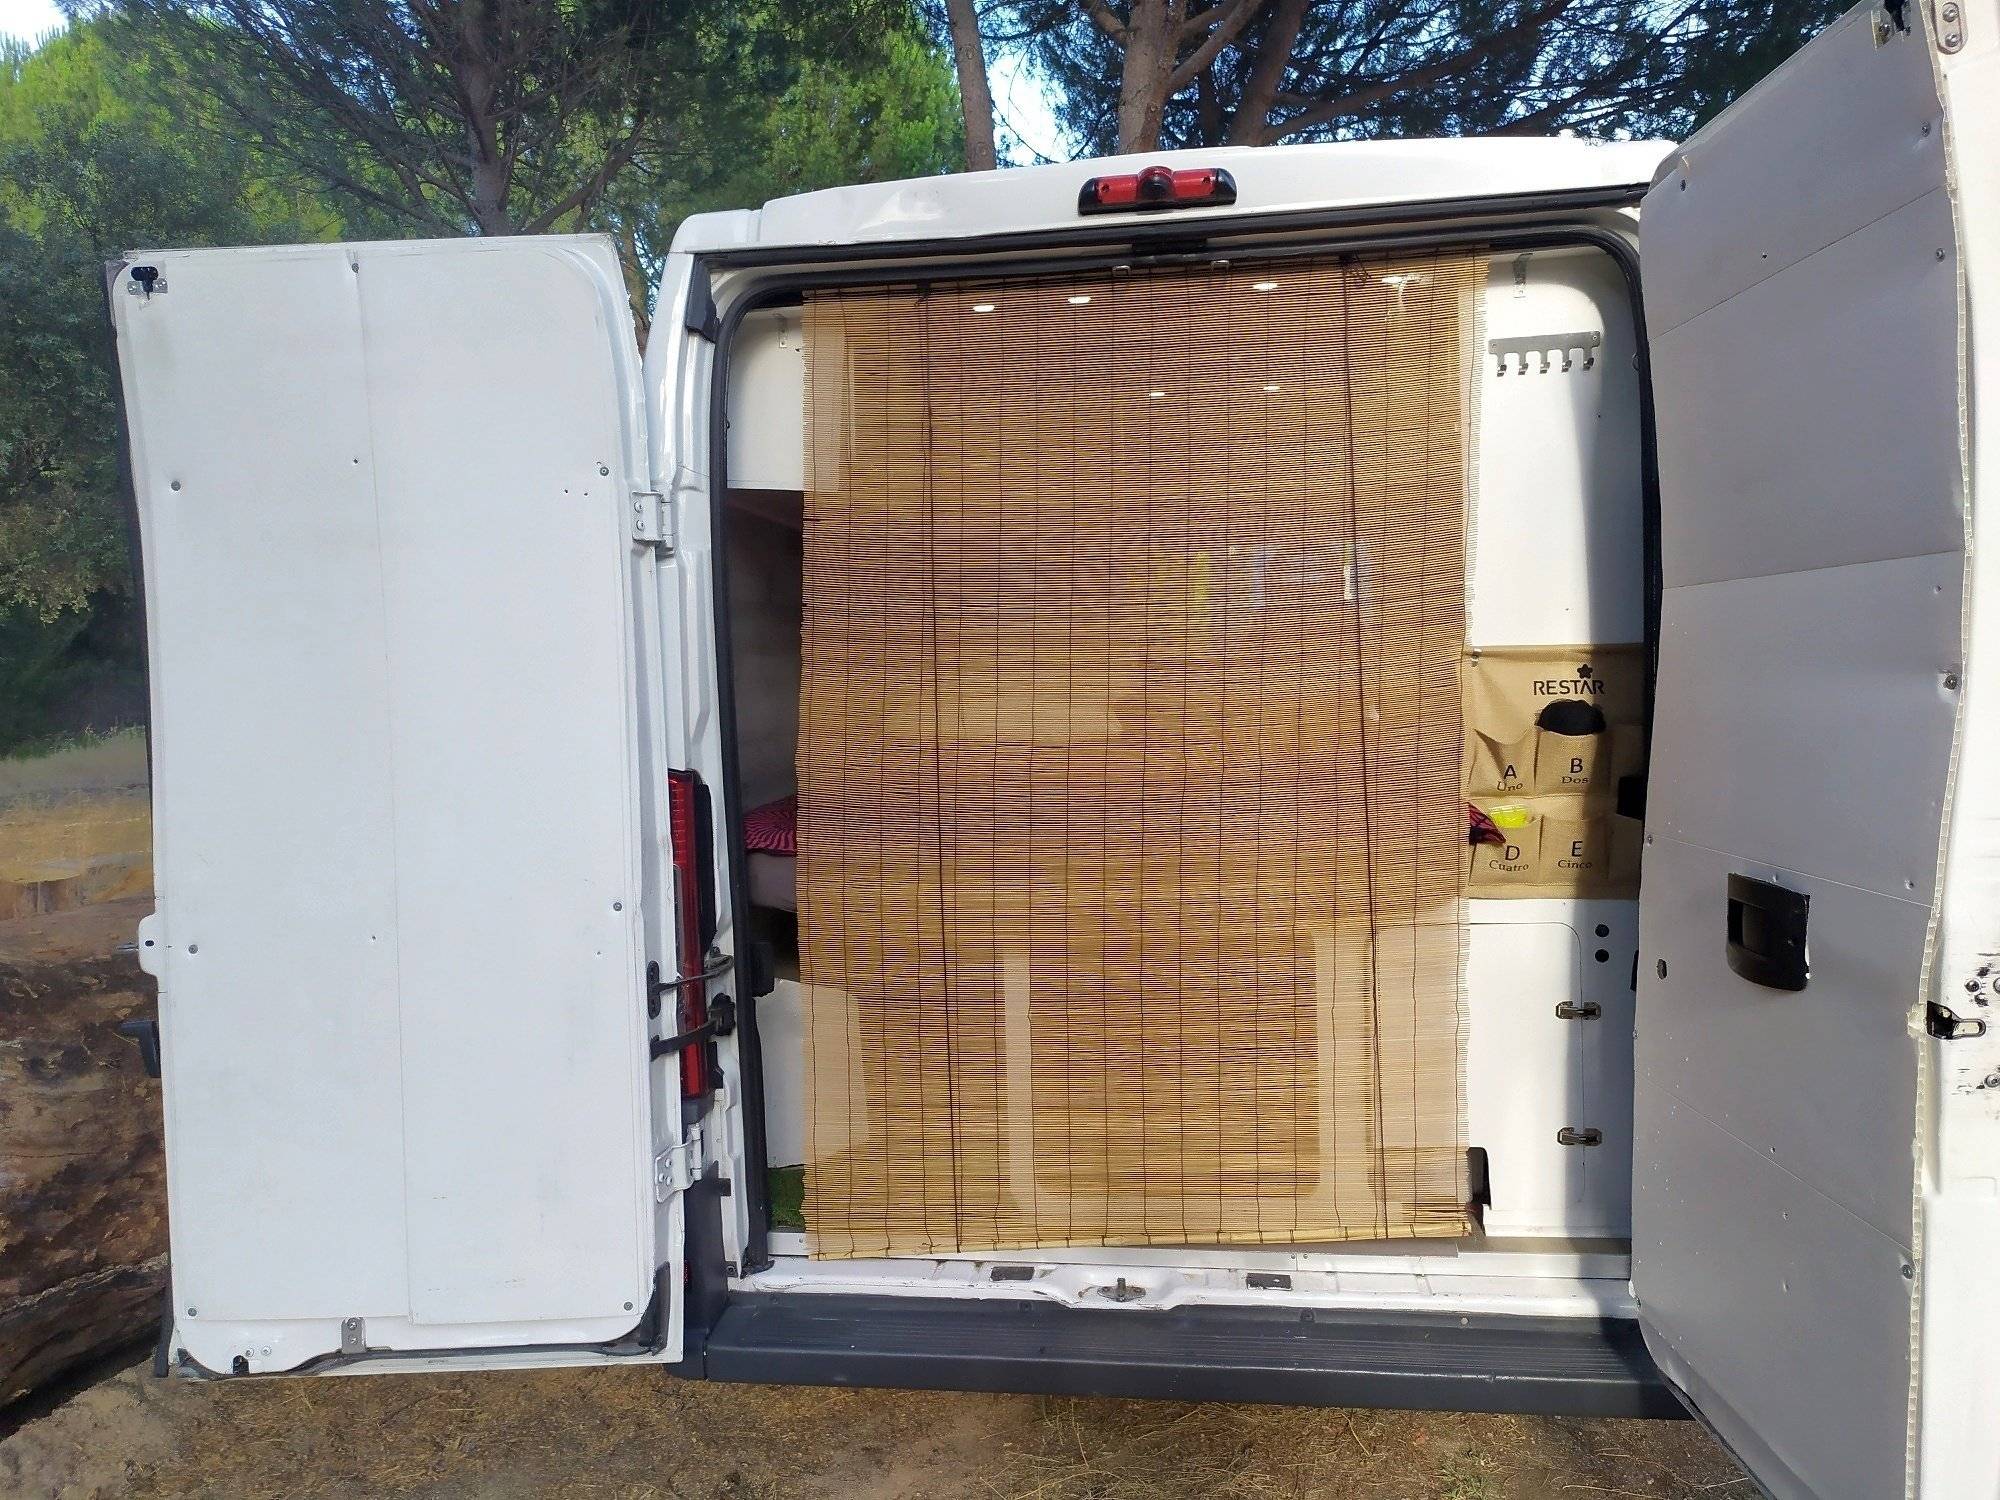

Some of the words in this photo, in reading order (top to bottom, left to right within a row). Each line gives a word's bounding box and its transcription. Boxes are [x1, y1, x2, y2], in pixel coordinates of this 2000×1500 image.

[1533, 680, 1604, 695] RESTAR
[1503, 765, 1517, 779] A
[1570, 758, 1583, 774] B
[1496, 781, 1523, 792] Uno
[1561, 776, 1589, 785] Dos
[1505, 845, 1520, 861] D
[1571, 841, 1583, 857] E
[1489, 860, 1529, 872] Cuatro
[1557, 860, 1593, 869] Cinco
